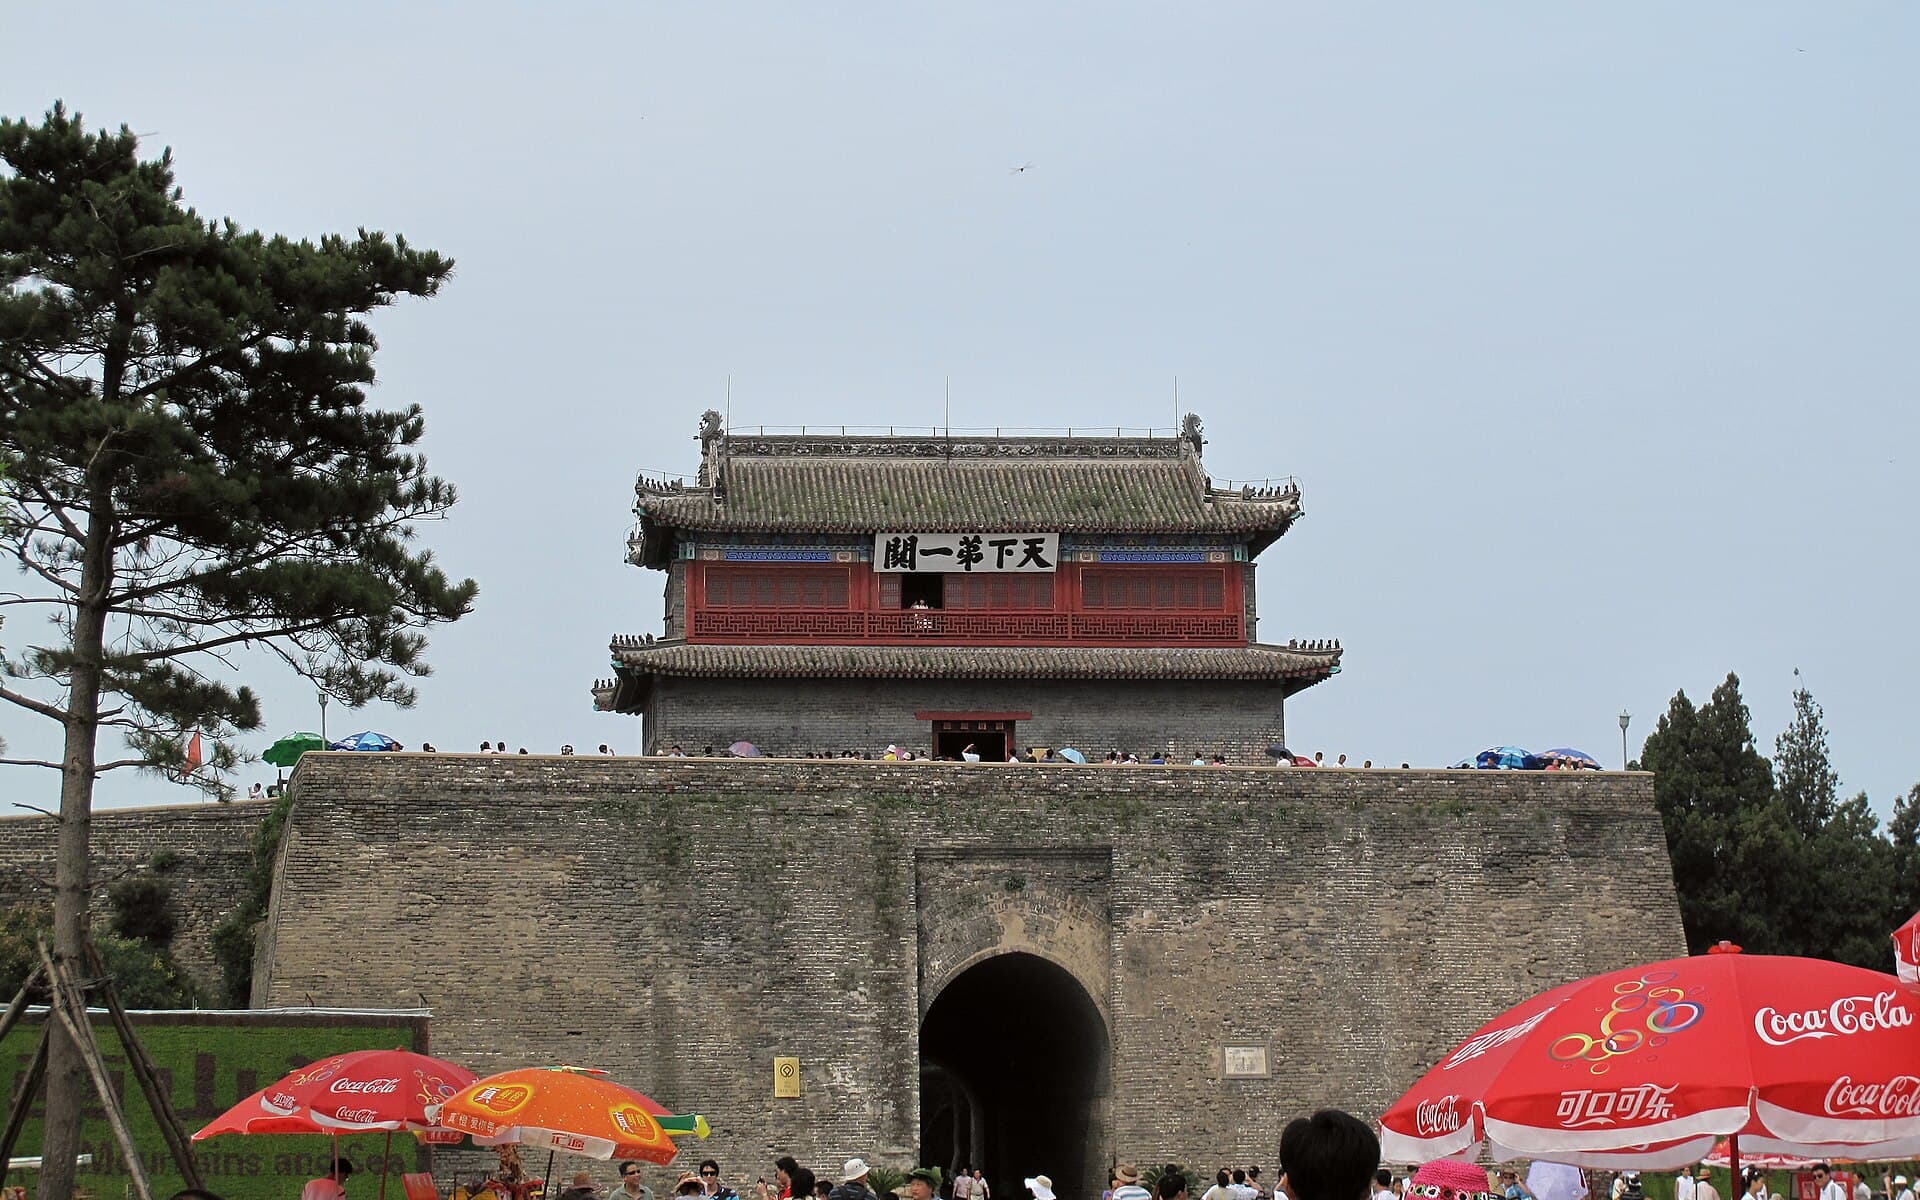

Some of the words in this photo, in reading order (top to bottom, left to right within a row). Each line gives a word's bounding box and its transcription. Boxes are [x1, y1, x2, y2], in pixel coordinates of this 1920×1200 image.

[1755, 990, 1913, 1046] Coca-Cola
[330, 1078, 401, 1094] Coca-Cola
[1556, 1083, 1679, 1127] 可口可乐
[1824, 1076, 1920, 1115] Coca-Col
[336, 1106, 378, 1123] Coca-Cola
[1416, 1095, 1460, 1136] Coca-Cola
